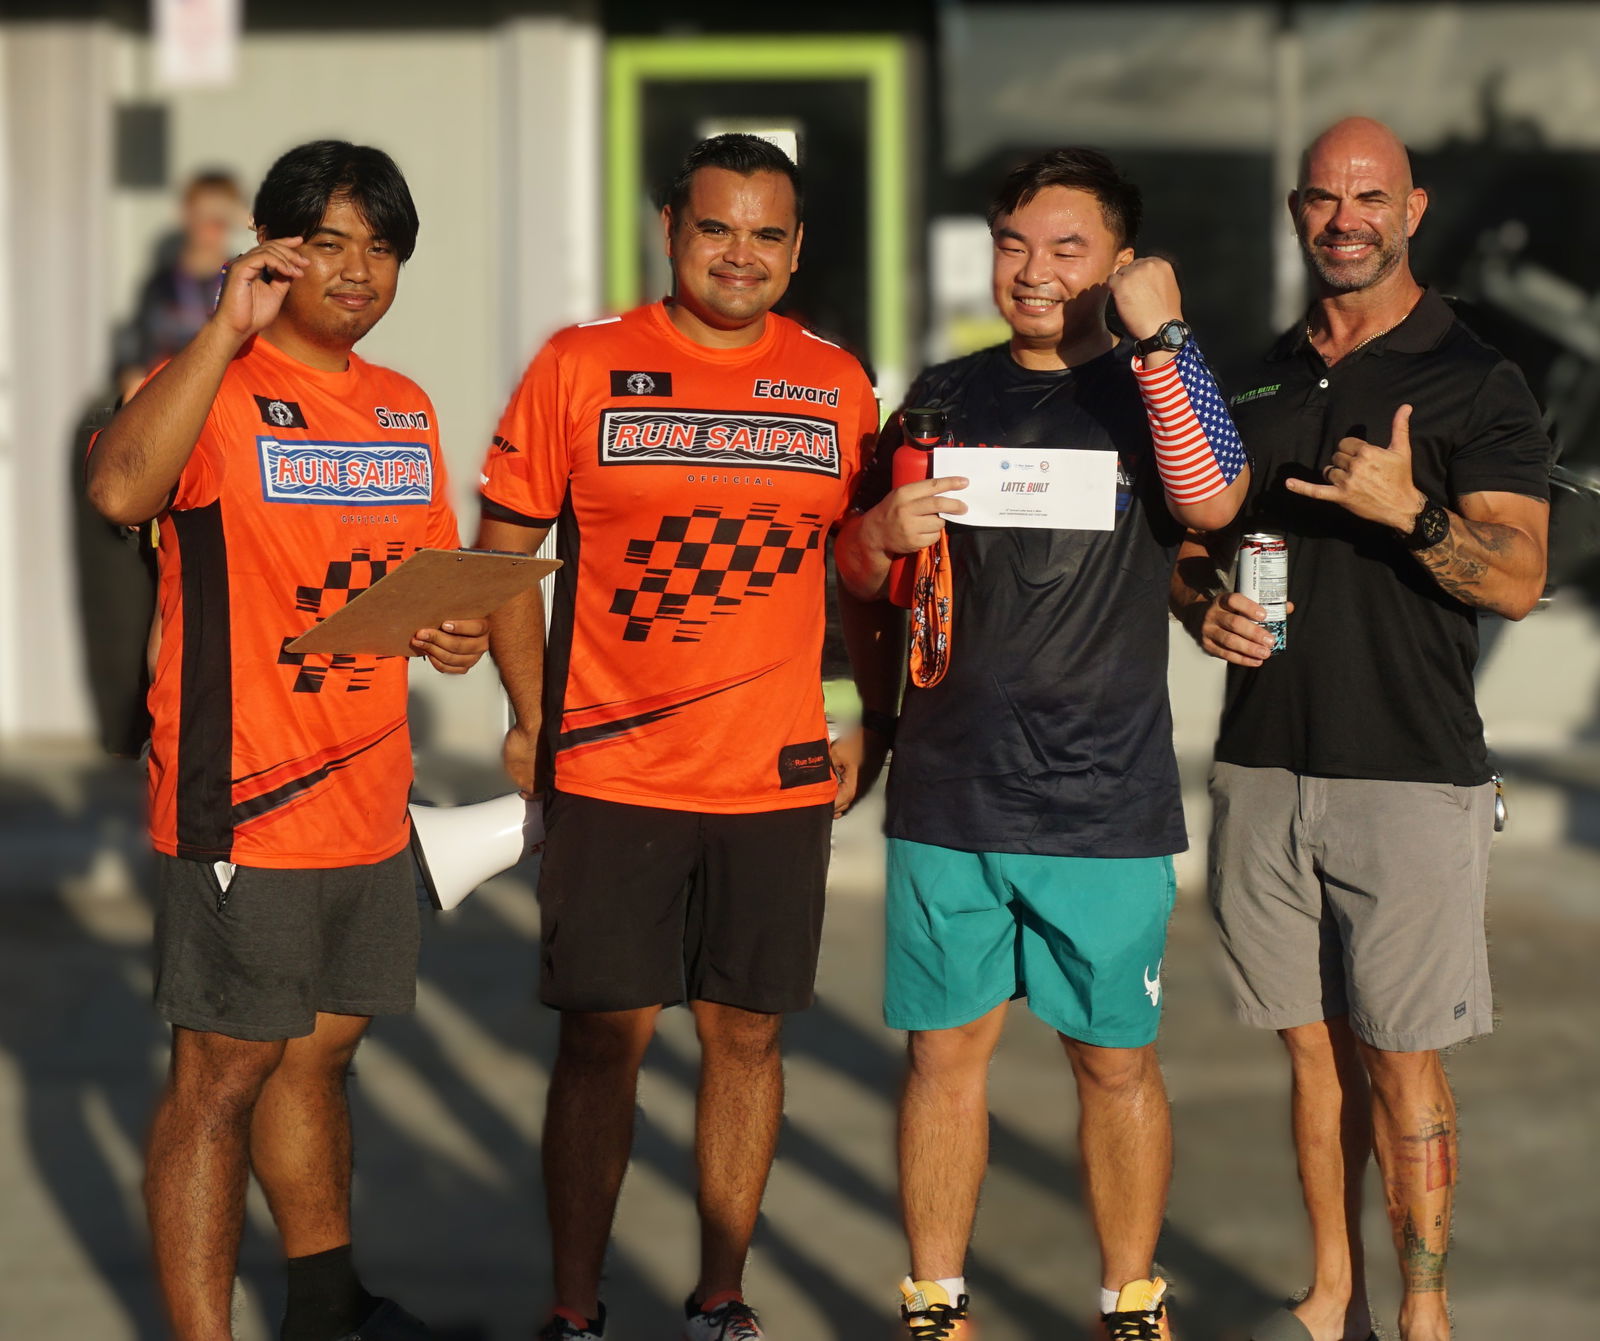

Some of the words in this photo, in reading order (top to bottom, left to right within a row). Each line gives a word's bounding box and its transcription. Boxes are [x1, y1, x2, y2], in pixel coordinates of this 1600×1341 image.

[753, 379, 840, 408] Edward
[375, 406, 430, 431] Simon
[613, 423, 697, 450] RUN
[704, 425, 831, 459] SAIPAN
[277, 455, 340, 487] RUN
[687, 475, 774, 486] OFFICIAL
[1000, 481, 1026, 493] LATTE
[1026, 482, 1050, 493] BUILT
[341, 514, 399, 524] OFFICIAL
